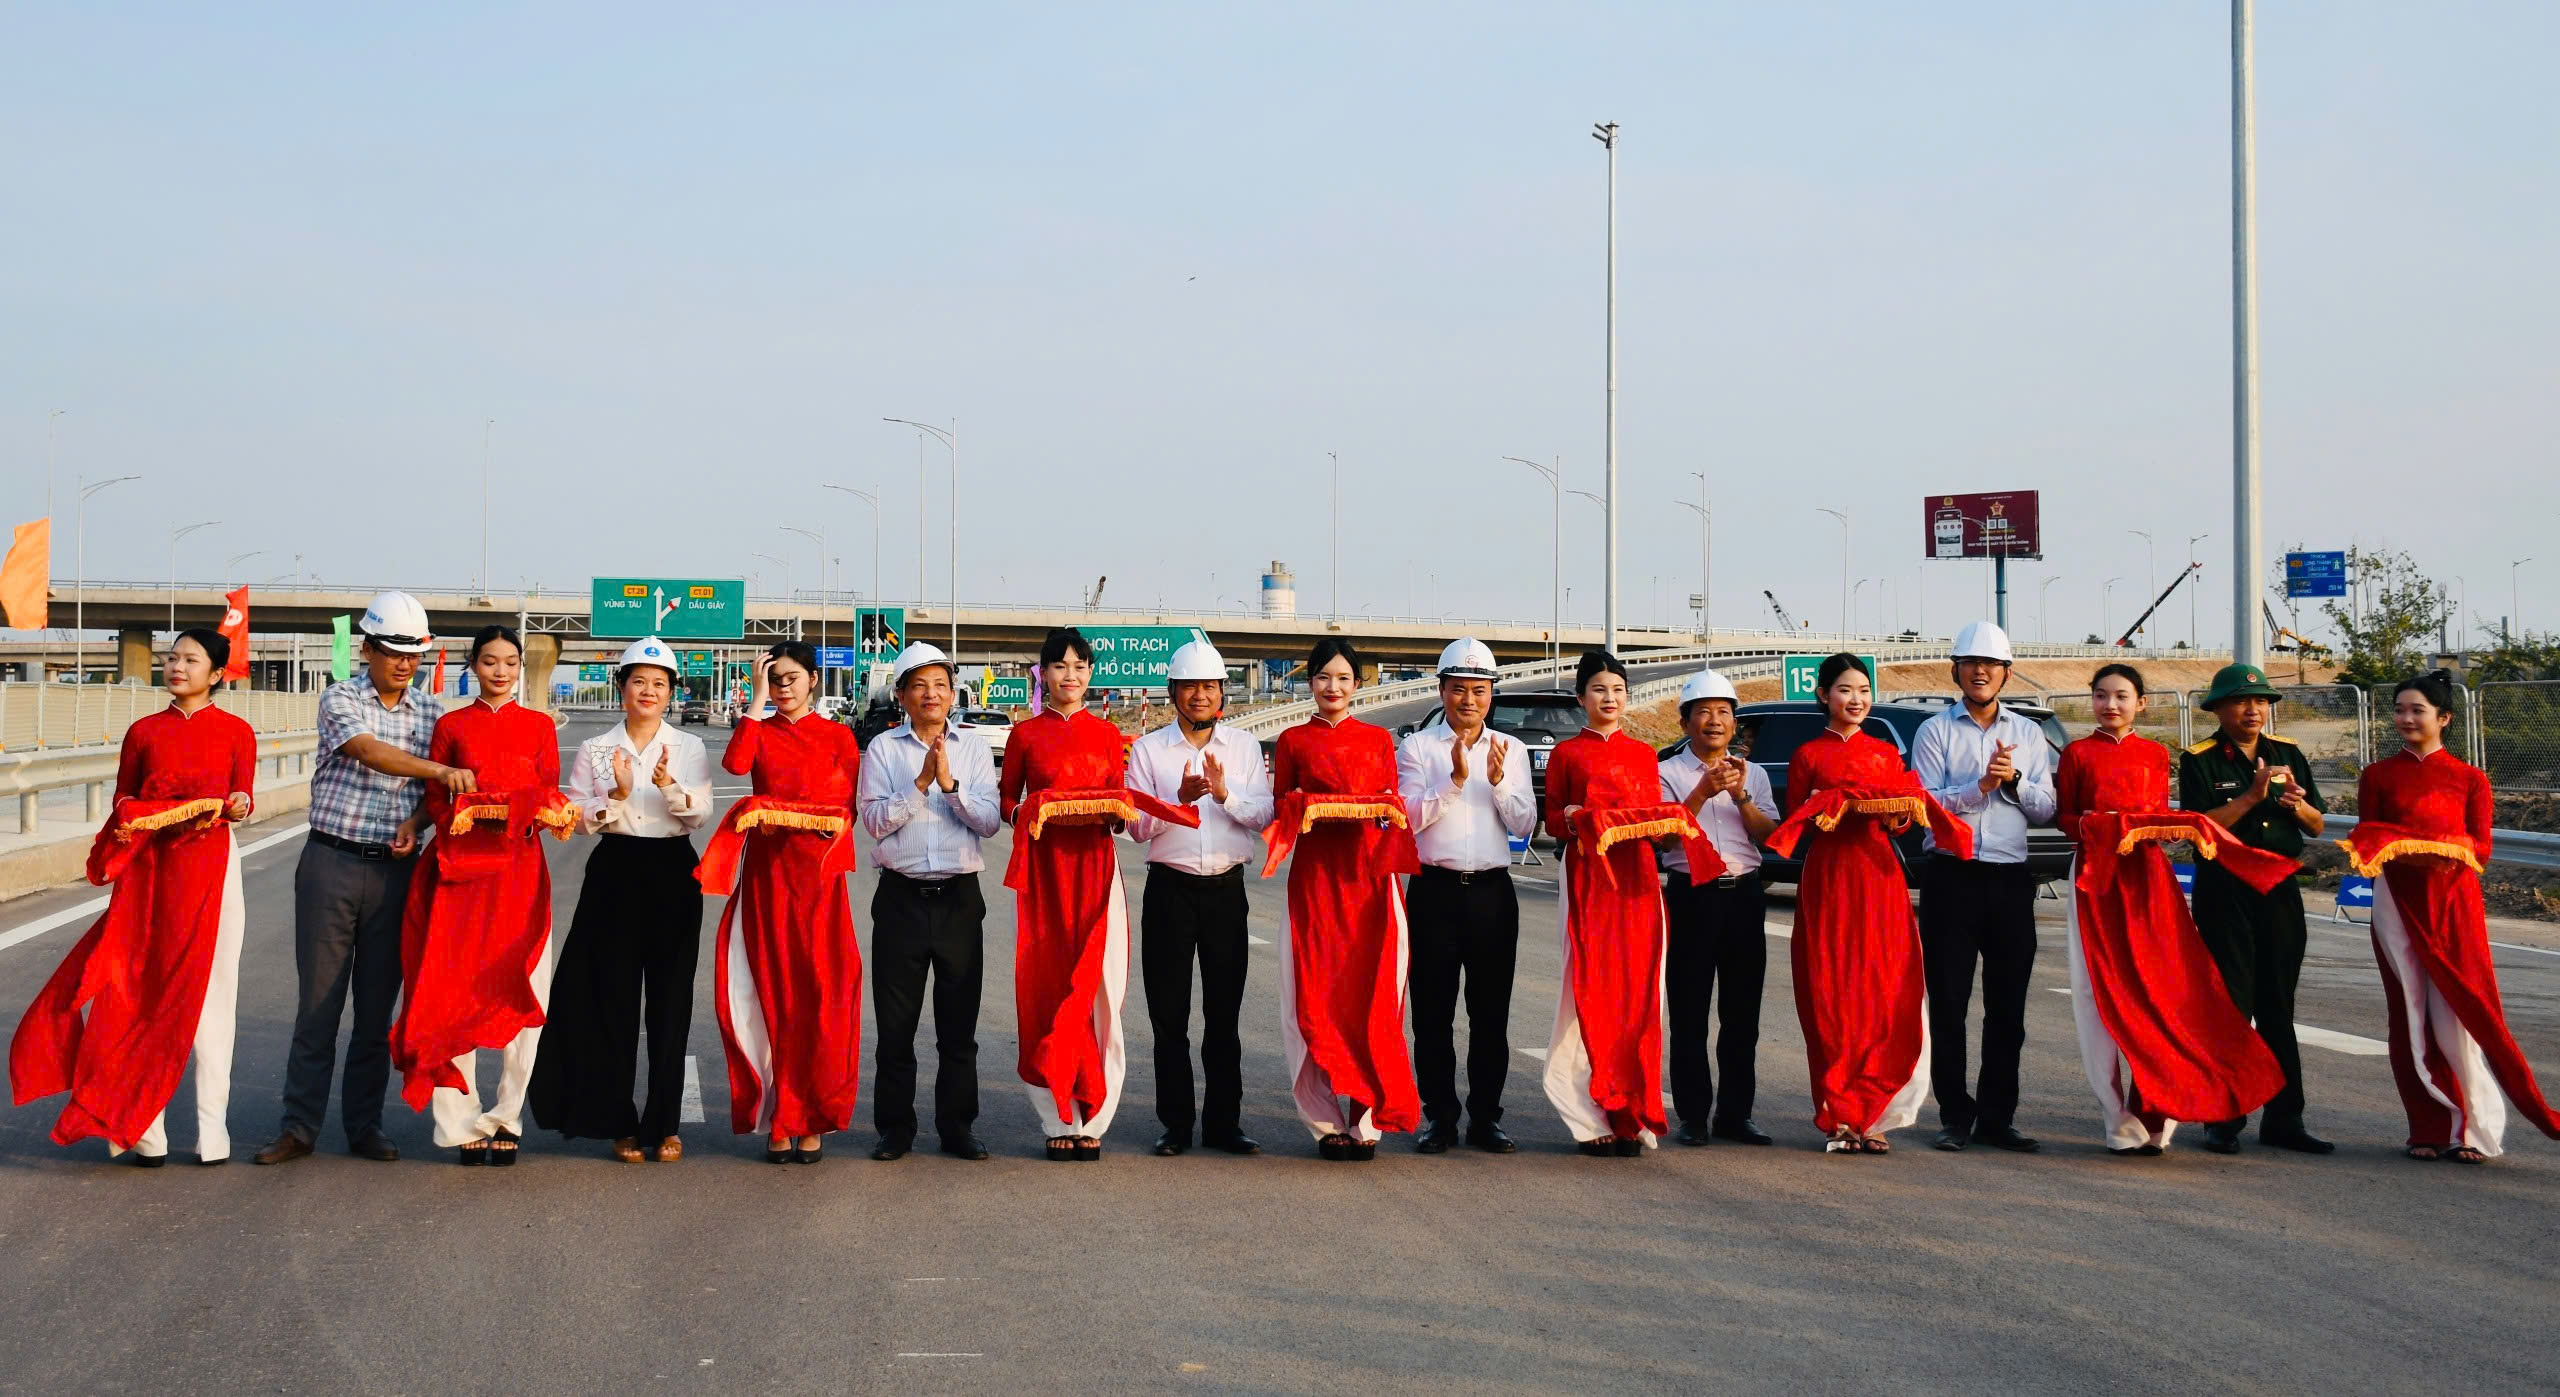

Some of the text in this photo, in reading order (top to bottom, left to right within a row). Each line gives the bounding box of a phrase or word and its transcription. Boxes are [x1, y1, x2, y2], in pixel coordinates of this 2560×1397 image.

[1087, 637, 1169, 655] HƠN TRẠCH
[1094, 656, 1170, 676] .HỒ CHÍ MIN
[1790, 667, 1818, 693] 15
